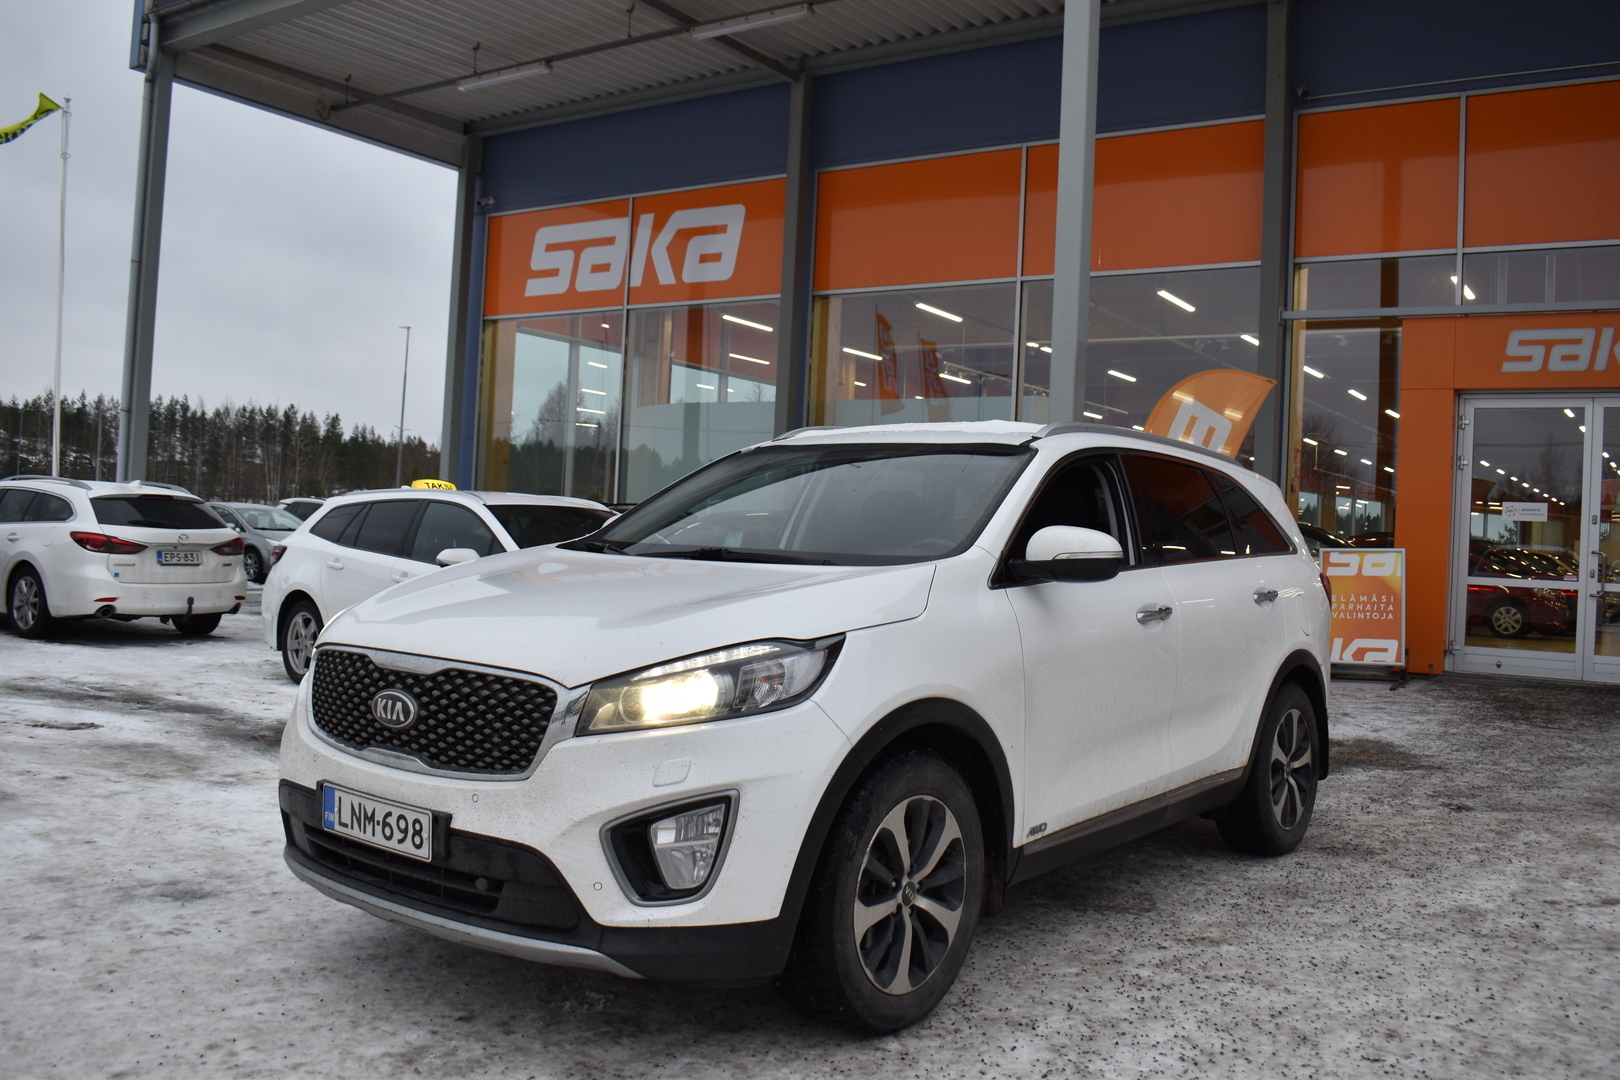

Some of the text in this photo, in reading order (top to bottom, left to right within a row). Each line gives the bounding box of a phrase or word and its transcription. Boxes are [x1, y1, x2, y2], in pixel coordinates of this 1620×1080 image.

[164, 552, 200, 563] EPS-831
[1331, 594, 1395, 603] ELÄMÄSI
[1331, 603, 1395, 612] PARHAITA
[1331, 611, 1395, 620] VALINTOJA
[376, 697, 406, 722] KIA
[337, 795, 424, 850] LNM-698
